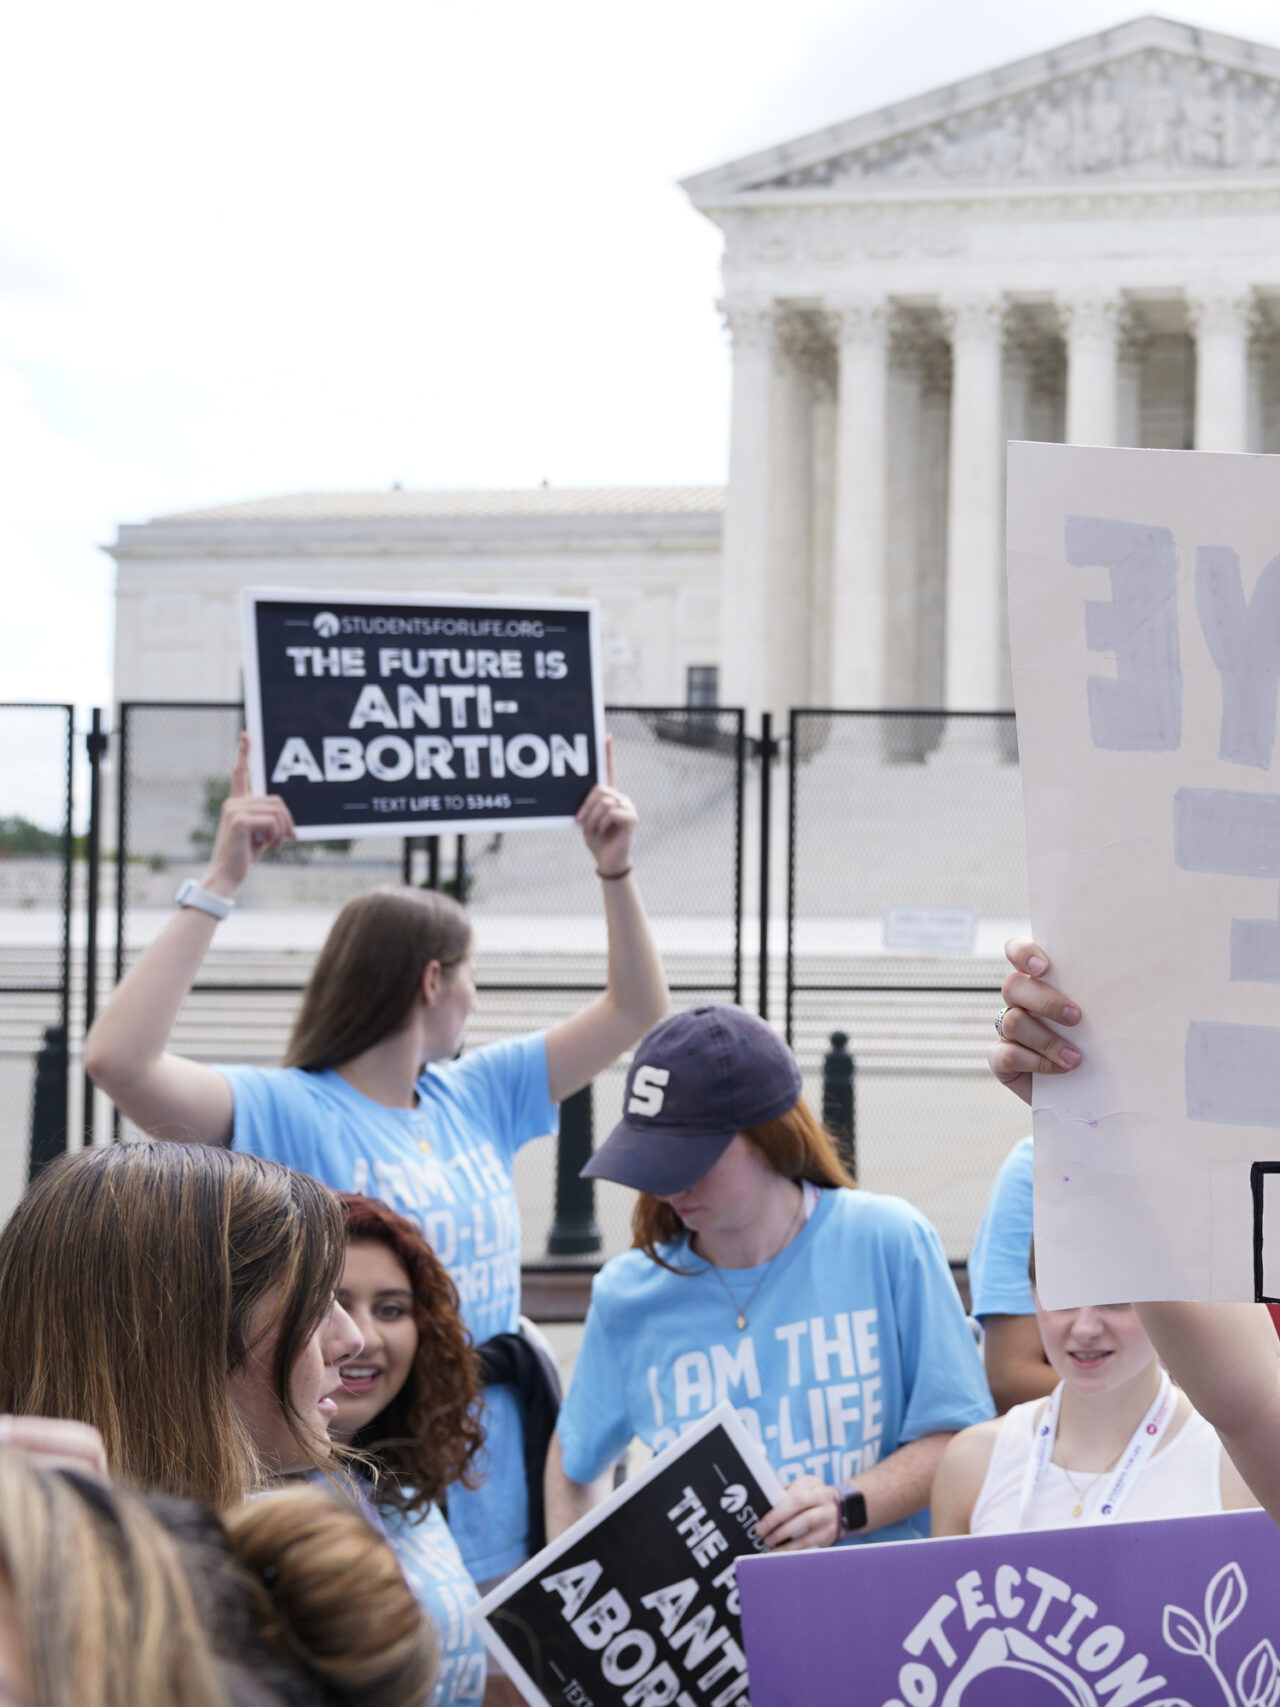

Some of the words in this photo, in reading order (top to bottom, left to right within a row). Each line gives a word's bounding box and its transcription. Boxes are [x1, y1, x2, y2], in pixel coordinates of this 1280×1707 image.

[340, 614, 546, 639] STUDENTSFORLIFE.ORG
[286, 645, 366, 678] THE
[378, 648, 524, 680] FUTURE
[534, 649, 569, 680] IS
[348, 683, 519, 730] ANTI-
[270, 733, 590, 784] ABORTION
[372, 797, 408, 813] TEXT
[409, 795, 442, 812] LIFE
[444, 795, 465, 811] TO
[466, 792, 512, 810] 53445
[627, 1064, 671, 1118] S
[673, 1335, 762, 1418] AM
[774, 1307, 882, 1388] THE
[667, 1486, 729, 1569] THE
[878, 1564, 1168, 1707] OTECTION
